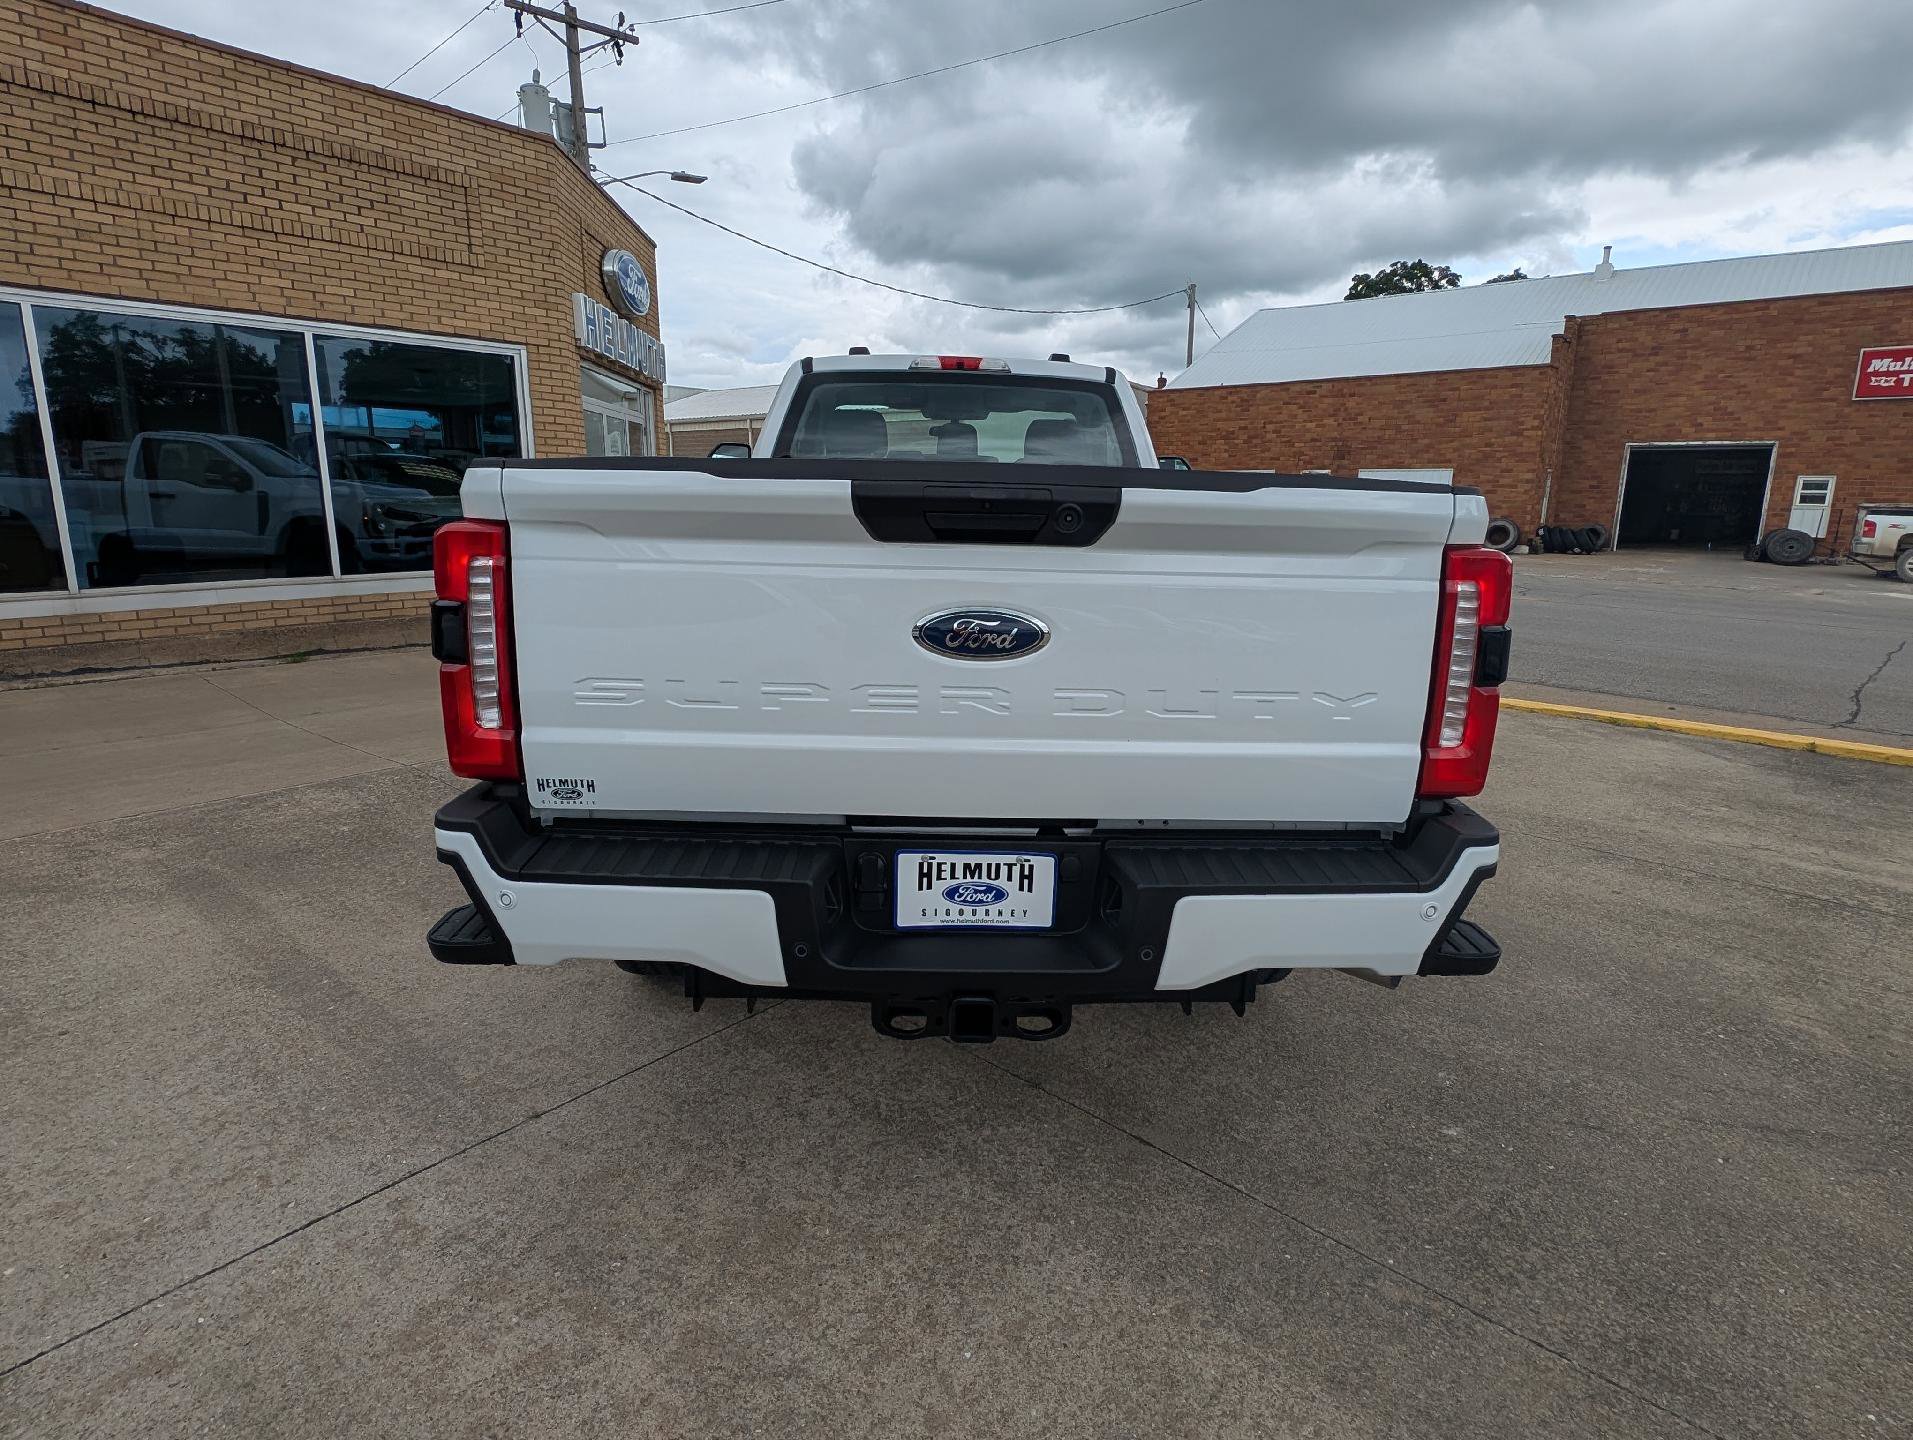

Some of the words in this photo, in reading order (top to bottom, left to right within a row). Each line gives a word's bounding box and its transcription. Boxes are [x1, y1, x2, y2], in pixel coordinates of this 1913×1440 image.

[574, 293, 667, 384] HELMUTH
[945, 618, 1019, 648] Ford
[574, 677, 1011, 714] SUPER
[1053, 688, 1378, 720] DUTY
[536, 778, 596, 793] HELMUTH
[917, 861, 1035, 893] HELMUTH
[954, 885, 997, 902] Ford
[921, 908, 1028, 918] SIGOURNEY
